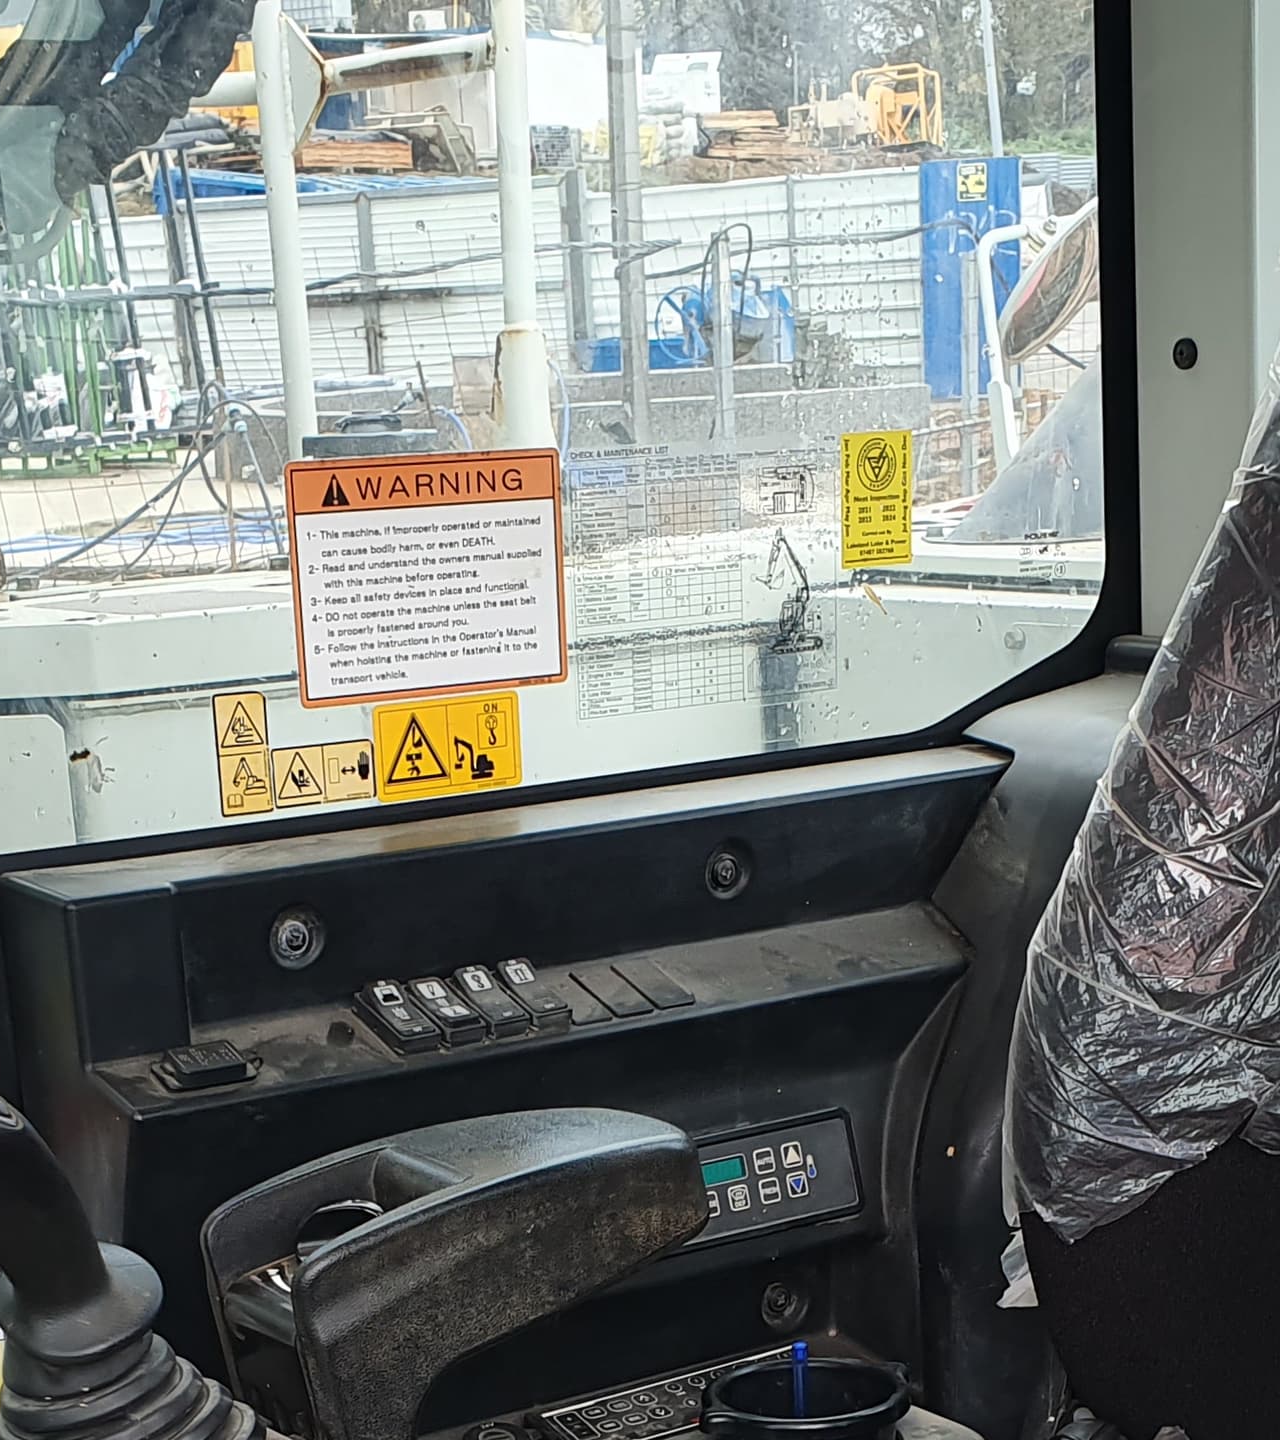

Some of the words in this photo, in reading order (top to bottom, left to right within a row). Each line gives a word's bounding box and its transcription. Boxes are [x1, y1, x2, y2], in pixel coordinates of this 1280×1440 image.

[570, 451, 593, 460] CHECK
[355, 468, 524, 500] WARNING
[319, 530, 340, 540] This
[383, 525, 391, 535] if
[391, 523, 439, 535] improperly
[441, 520, 481, 532] operated
[482, 520, 492, 529] or
[494, 515, 541, 528] maintained
[321, 549, 339, 558] can
[340, 547, 368, 557] cause
[369, 543, 397, 555] bodily
[426, 542, 436, 550] or
[438, 540, 460, 550] even
[322, 562, 346, 573] Read
[348, 561, 366, 572] and
[367, 557, 419, 570] understand
[421, 556, 437, 566] the
[438, 555, 471, 565] owners
[472, 550, 505, 562] manual
[506, 548, 542, 560] supplied
[323, 579, 344, 589] with
[346, 577, 363, 588] this
[365, 575, 403, 585] machine
[405, 572, 434, 583] before
[324, 596, 348, 606] Keep
[350, 593, 361, 604] all
[363, 592, 391, 603] safety
[393, 587, 427, 600] devices
[428, 588, 437, 597] in
[439, 586, 463, 597] place
[465, 583, 482, 594] and
[325, 611, 340, 623] DO
[342, 611, 358, 621] not
[360, 609, 395, 619] operate
[397, 607, 412, 616] the
[414, 604, 451, 614] machine
[452, 600, 481, 612] unless
[483, 599, 497, 609] the
[499, 598, 518, 607] seat
[519, 595, 537, 606] belt
[327, 628, 335, 638] is
[337, 625, 374, 637] properly
[376, 621, 416, 633] fastened
[418, 618, 449, 630] around
[327, 643, 357, 653] Follow
[359, 642, 375, 650] the
[377, 637, 429, 649] instructions
[431, 635, 440, 644] in
[442, 634, 457, 643] the
[458, 628, 504, 642] Operator's
[506, 625, 537, 637] Manual
[329, 659, 354, 669] when
[356, 655, 392, 665] hoisting
[394, 653, 409, 663] the
[411, 650, 448, 660] machine
[450, 649, 459, 658] or
[462, 643, 502, 656] fastening
[503, 643, 510, 652] it
[512, 643, 522, 651] to
[523, 641, 538, 650] the
[330, 673, 373, 686] transport
[483, 702, 499, 713] ON
